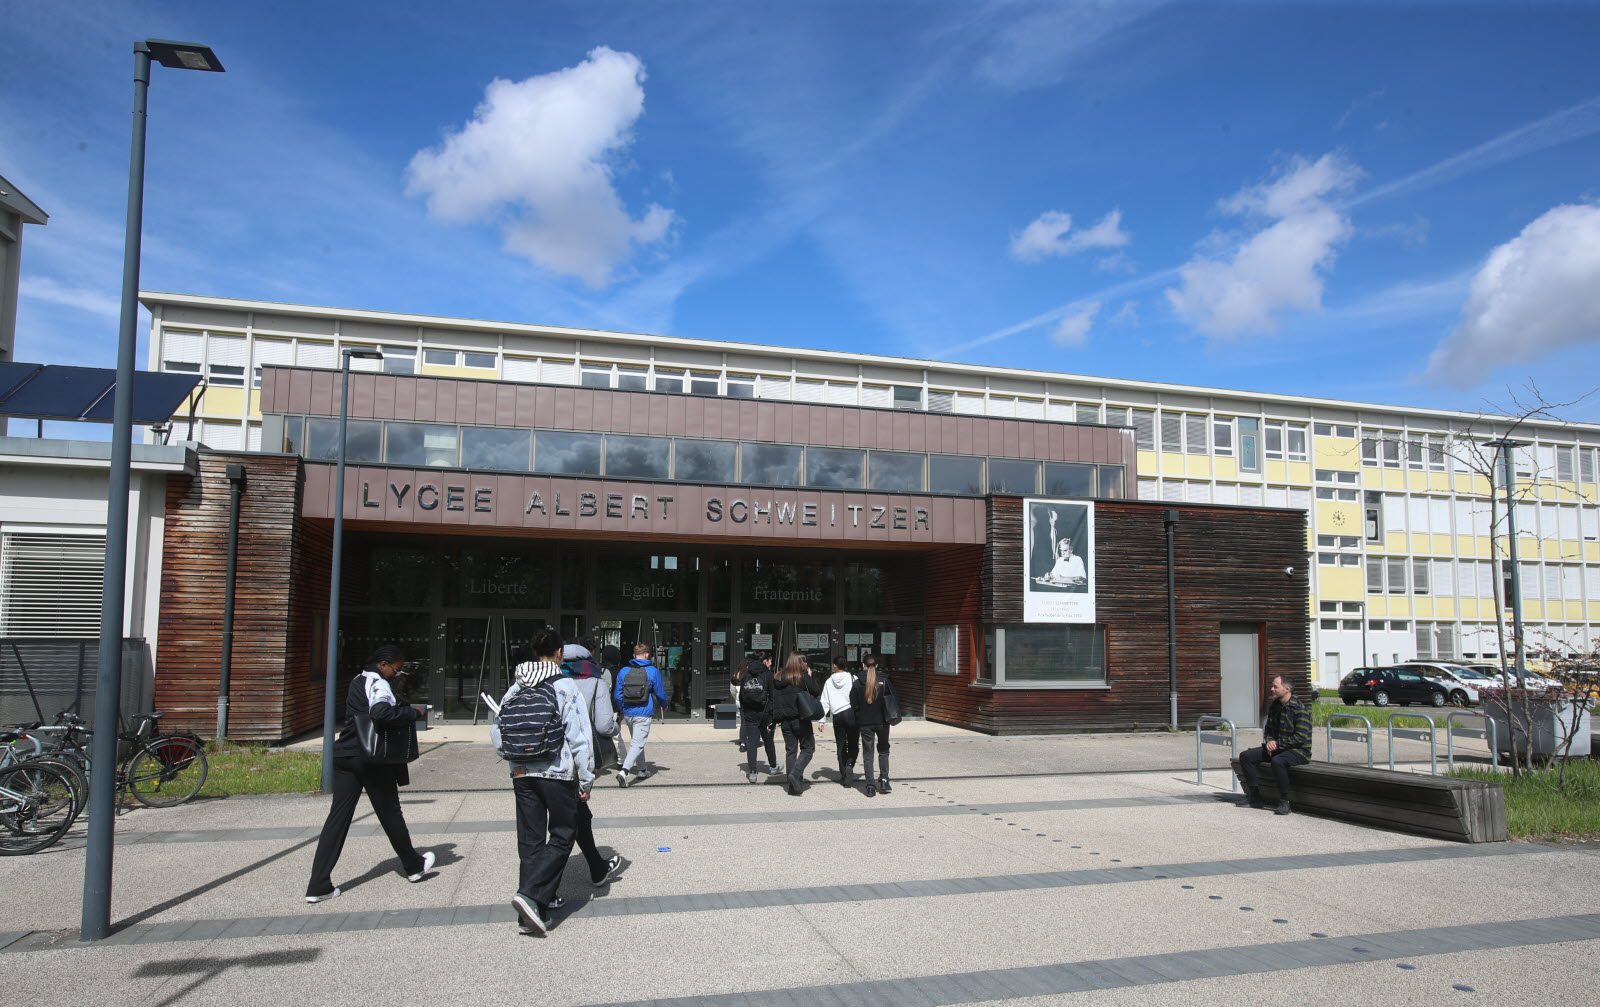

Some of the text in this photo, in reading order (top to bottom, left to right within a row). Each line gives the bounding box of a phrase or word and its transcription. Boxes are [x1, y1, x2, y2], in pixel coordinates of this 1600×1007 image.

[364, 481, 930, 531] LYCEE ALBERT SCHWEITZER
[470, 579, 529, 595] Liberté
